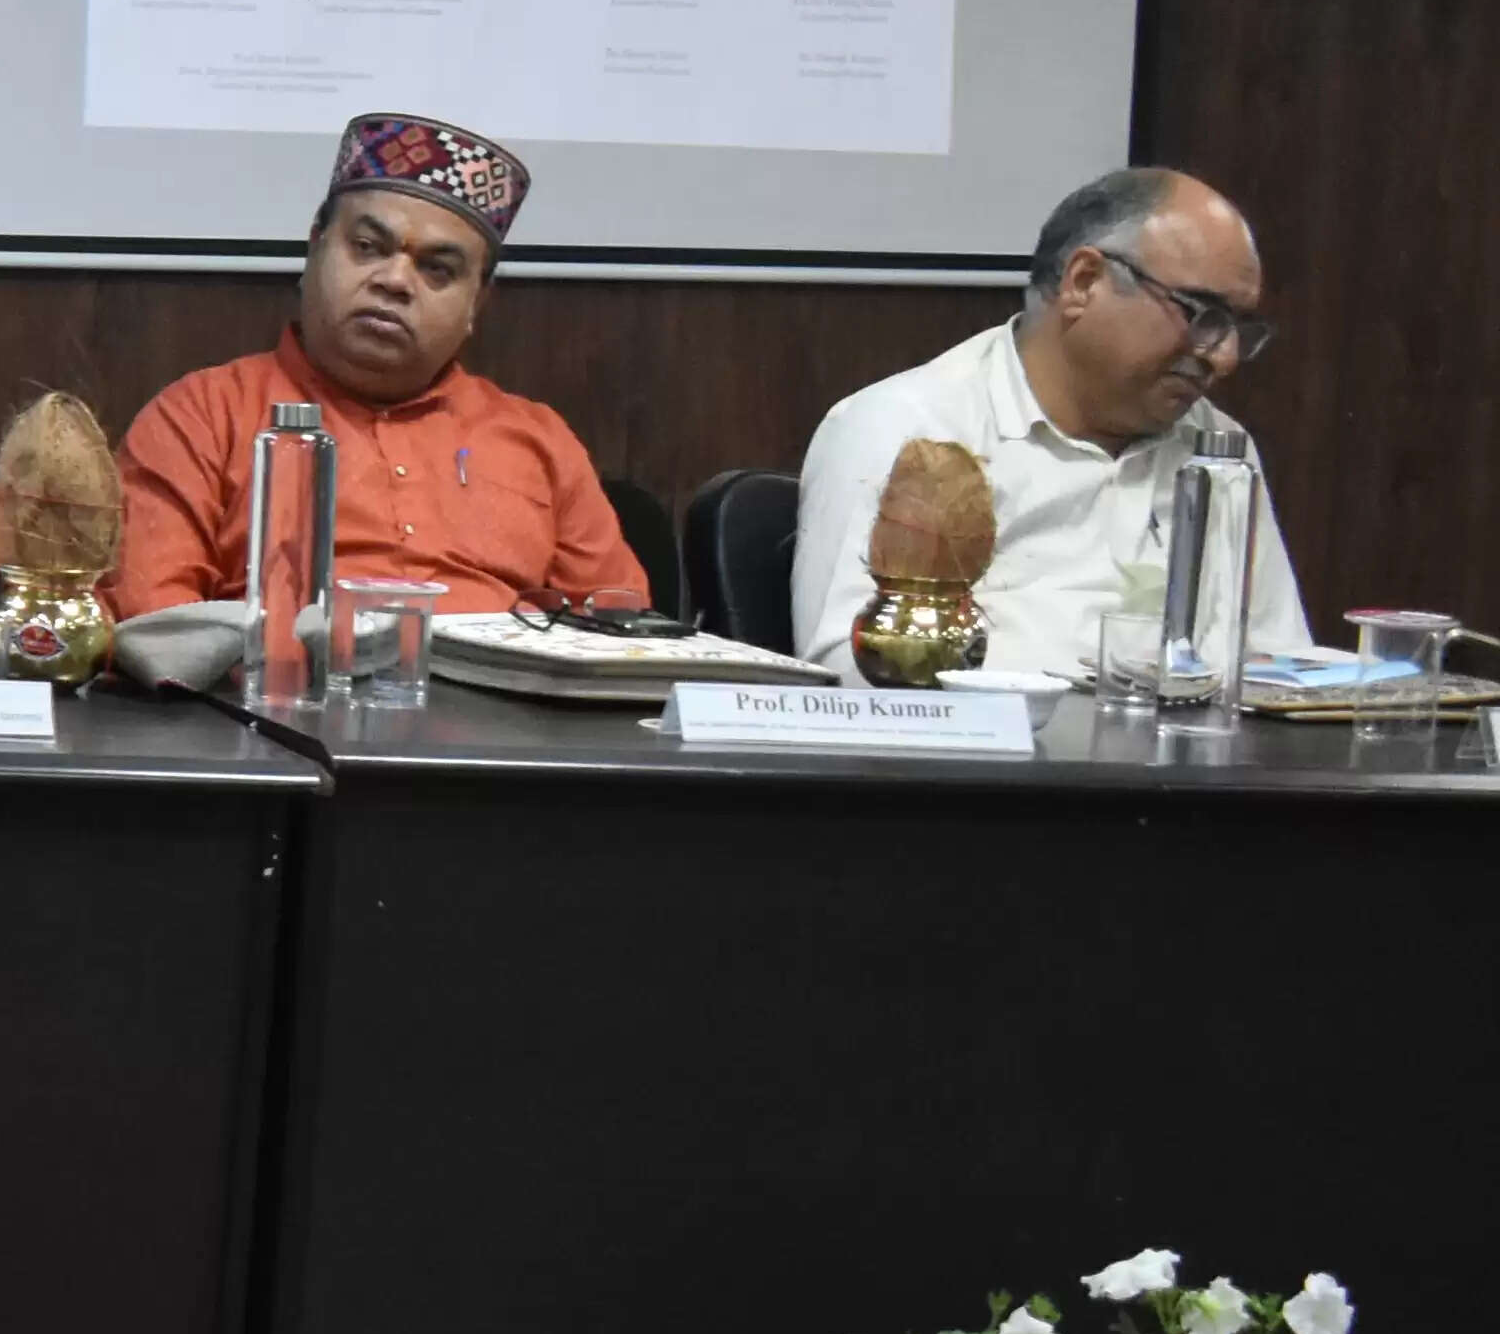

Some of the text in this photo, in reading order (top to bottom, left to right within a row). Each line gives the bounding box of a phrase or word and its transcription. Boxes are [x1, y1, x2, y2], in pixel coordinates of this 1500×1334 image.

[735, 692, 956, 720] Prof. Dilip Kumar
